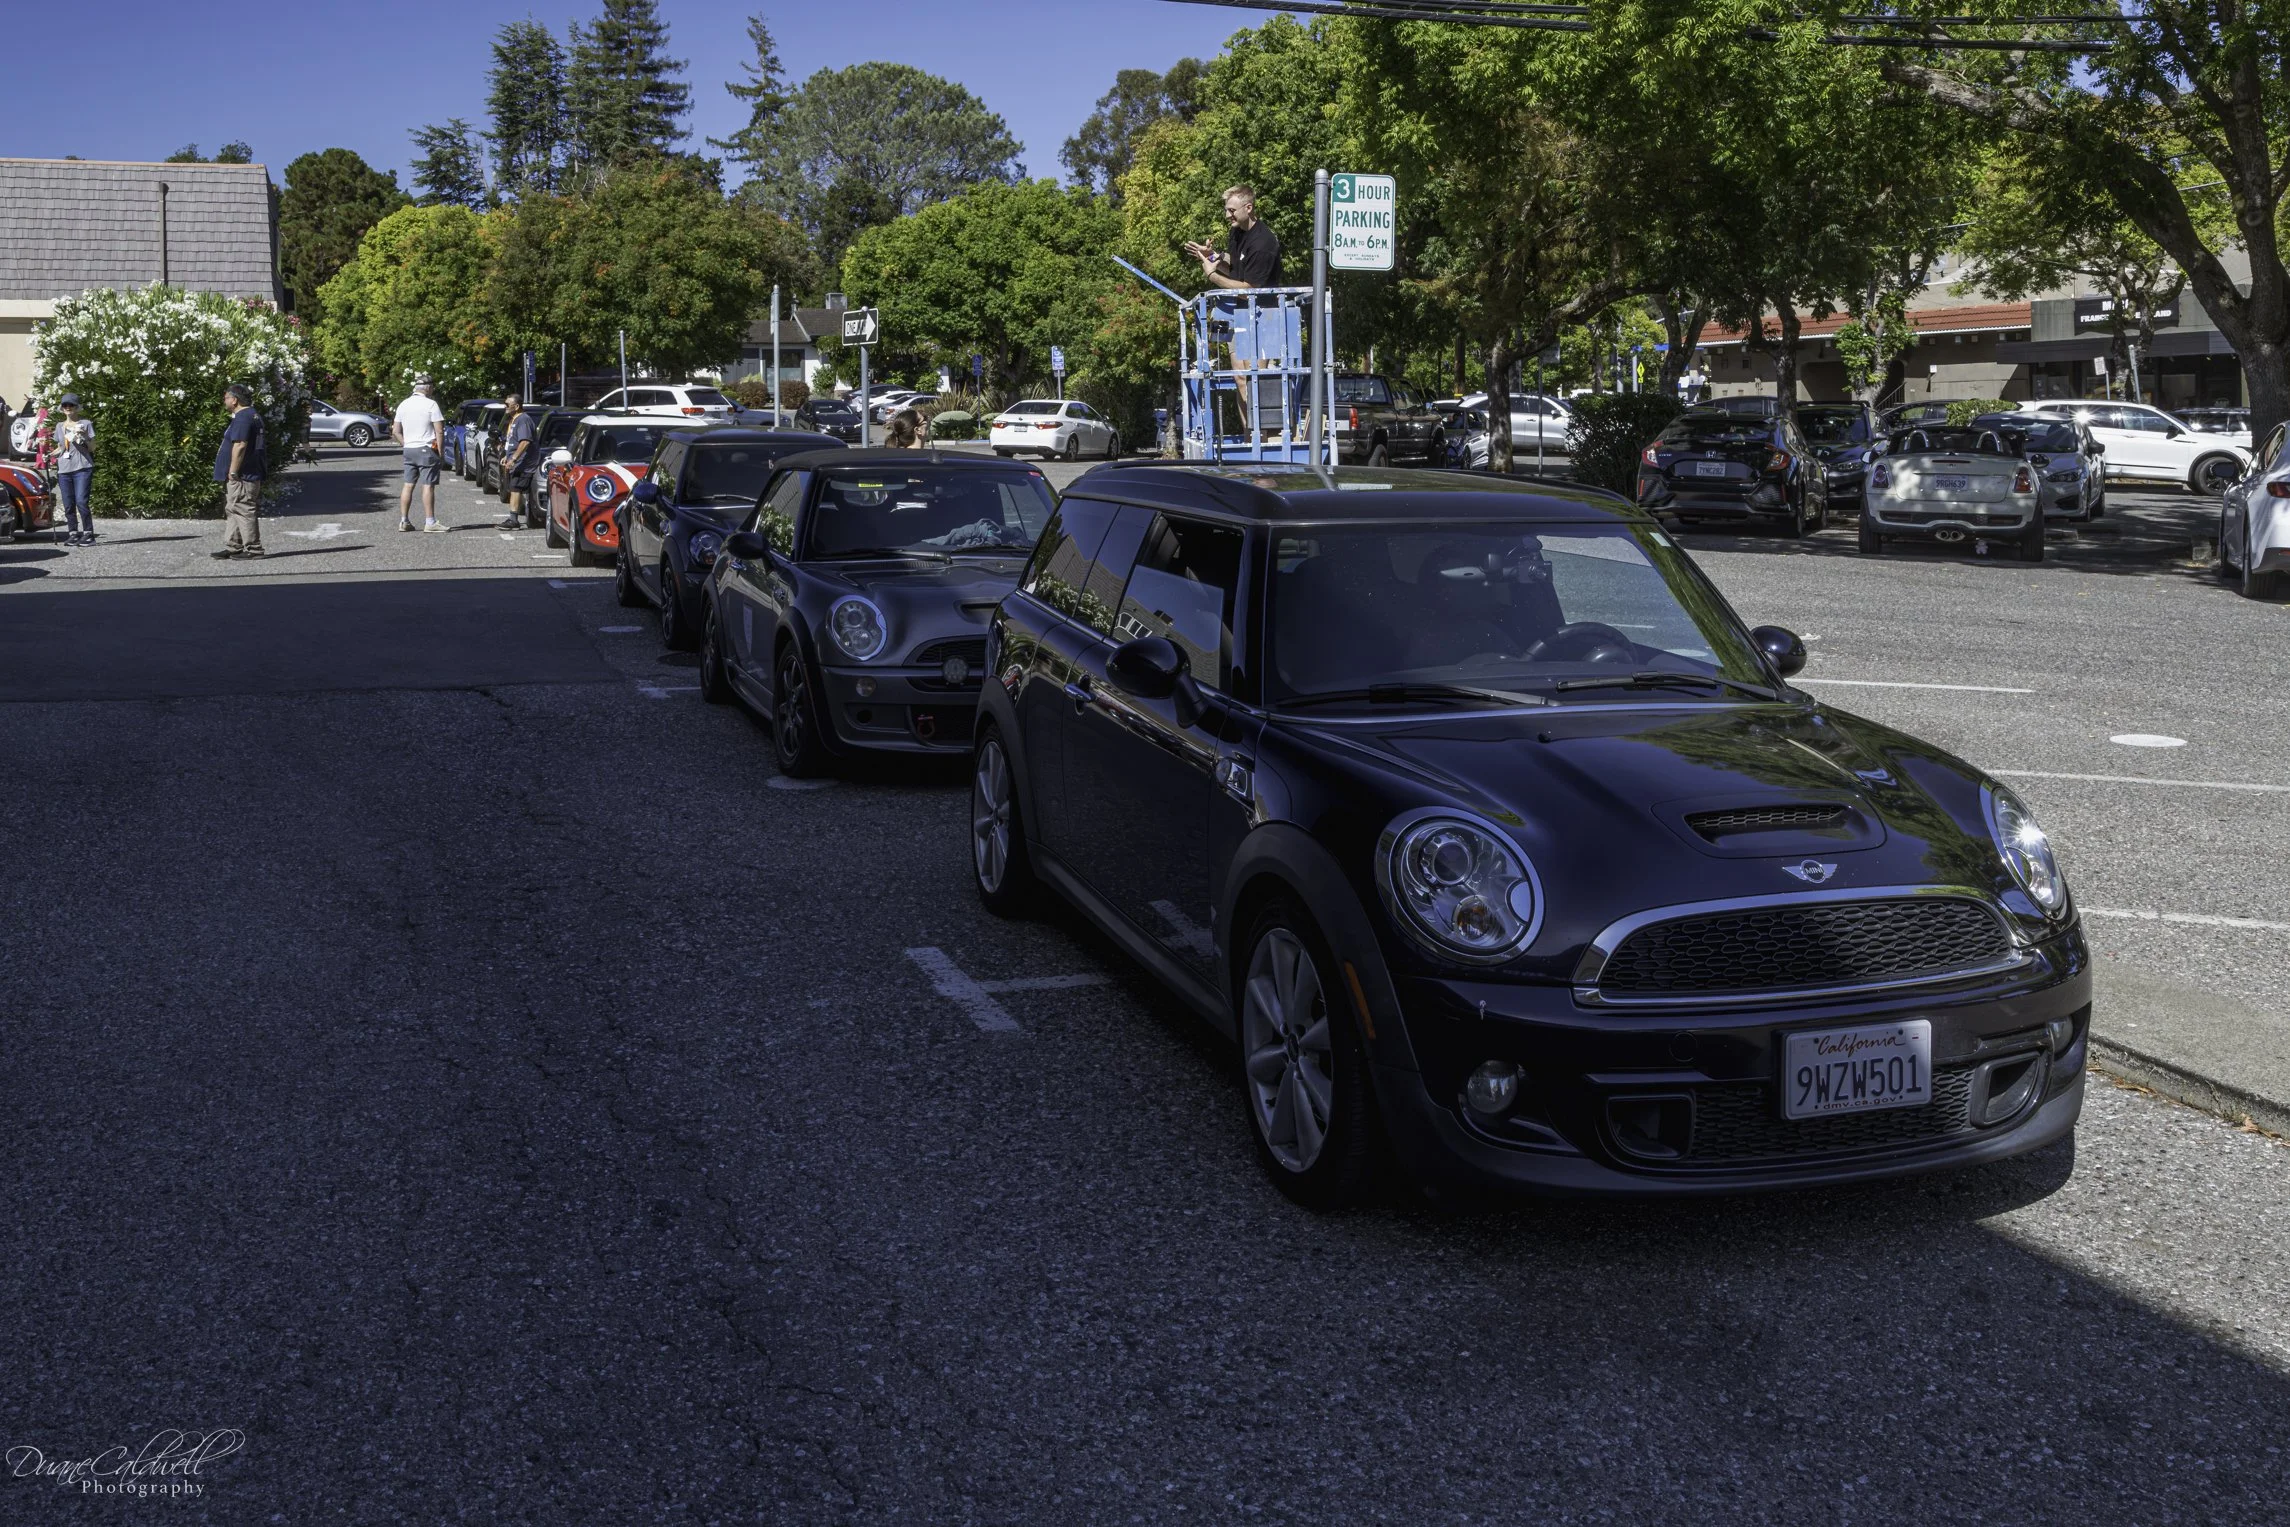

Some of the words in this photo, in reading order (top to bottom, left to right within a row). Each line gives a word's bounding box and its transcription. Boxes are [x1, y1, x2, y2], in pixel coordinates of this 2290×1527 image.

[1336, 178, 1351, 199] 3
[1358, 185, 1391, 201] HOUR
[1335, 210, 1390, 229] PARKING
[1817, 1031, 1906, 1058] California
[1796, 1054, 1922, 1106] 9WZW501
[1823, 1096, 1897, 1110] dmv.ca.gov
